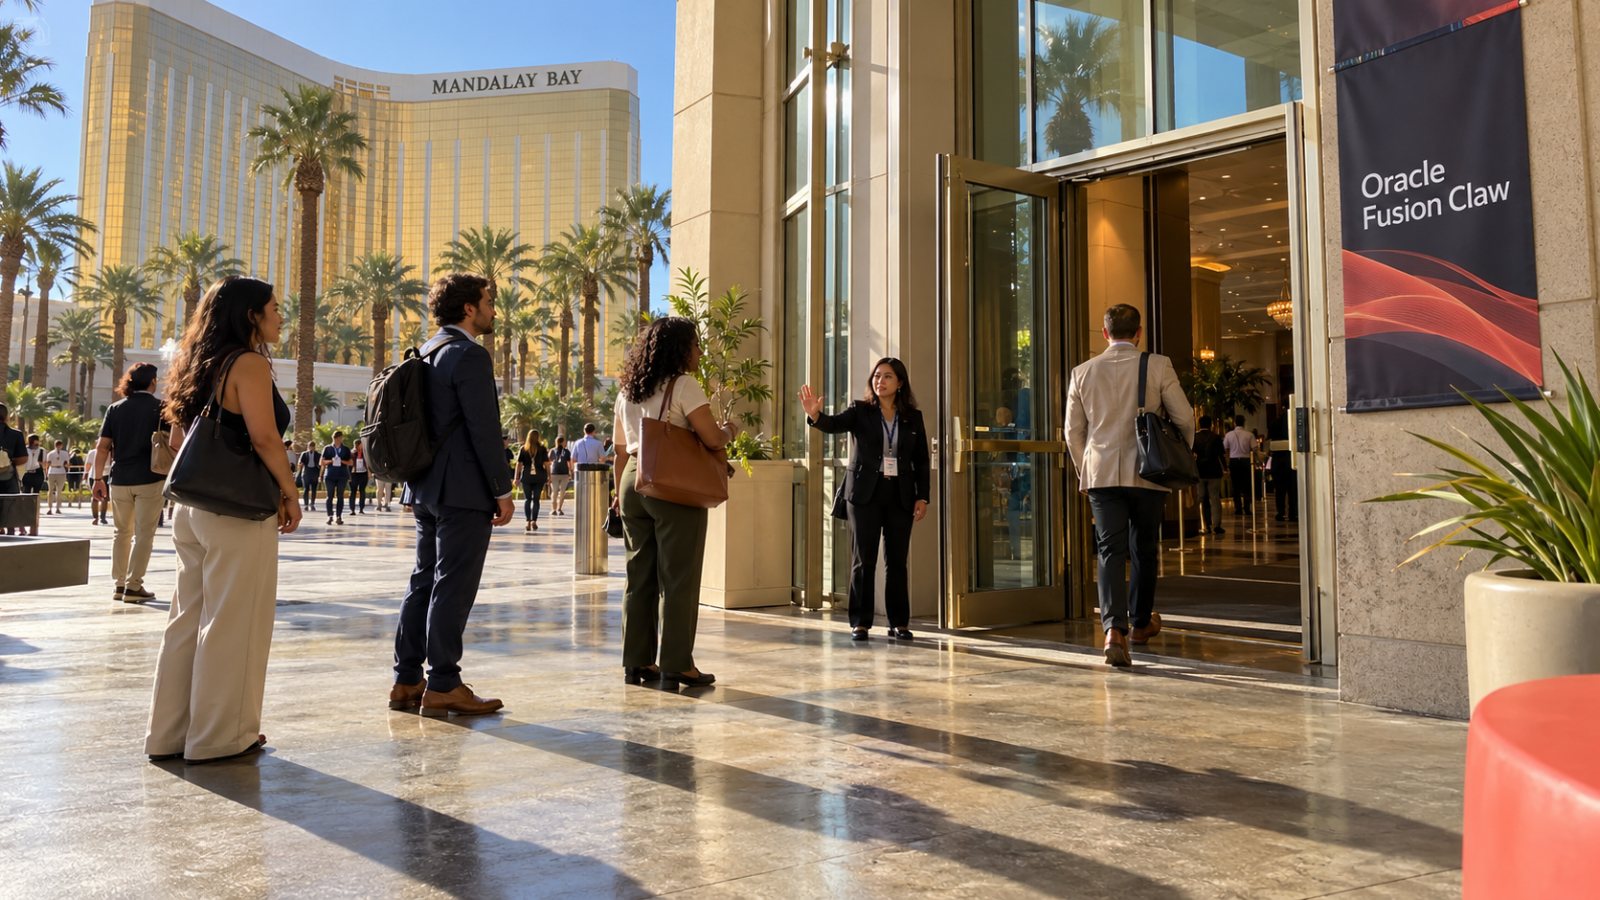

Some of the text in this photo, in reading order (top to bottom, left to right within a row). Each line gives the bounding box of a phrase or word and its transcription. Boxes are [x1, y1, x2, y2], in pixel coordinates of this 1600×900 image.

[432, 69, 583, 95] MANDALAY BAY
[1361, 160, 1446, 199] Oracle
[1362, 180, 1510, 230] Fusion Claw
